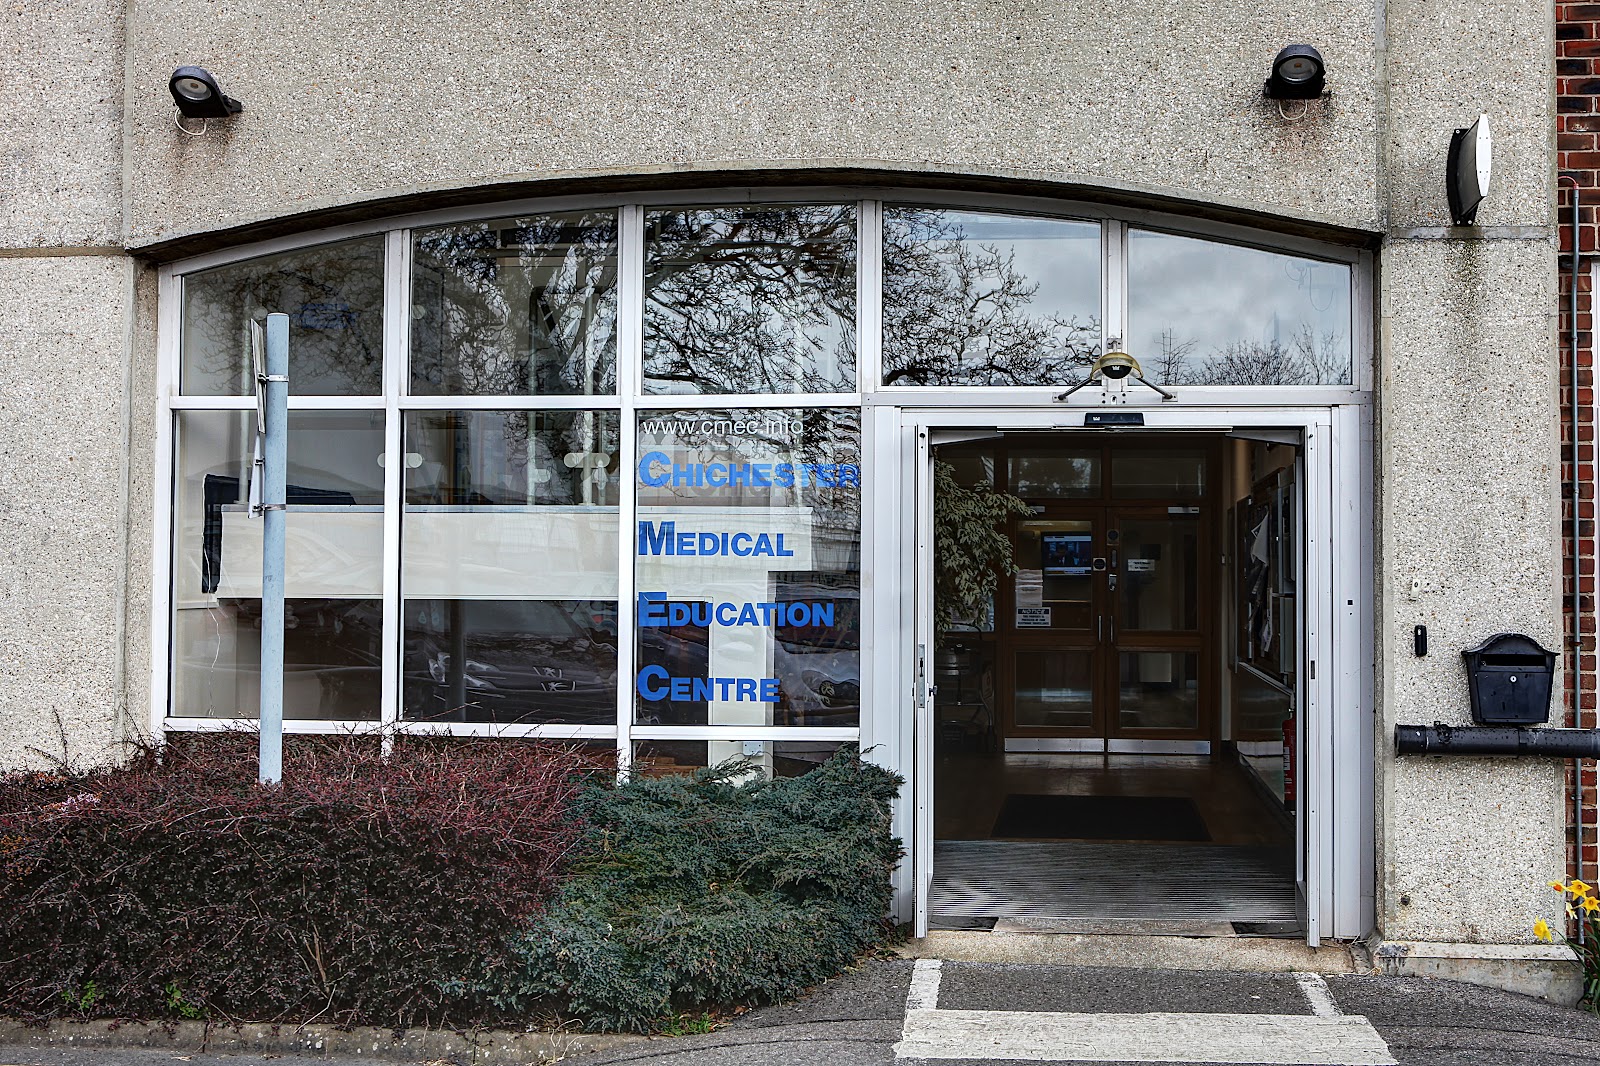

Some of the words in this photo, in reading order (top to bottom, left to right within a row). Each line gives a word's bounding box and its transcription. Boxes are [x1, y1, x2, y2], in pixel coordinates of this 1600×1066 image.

[643, 419, 804, 435] www.cmec.info
[638, 451, 860, 488] CHICHESTER
[638, 521, 794, 557] MEDICAL
[638, 591, 835, 627] EDUCATION
[637, 665, 781, 702] CENTRE
